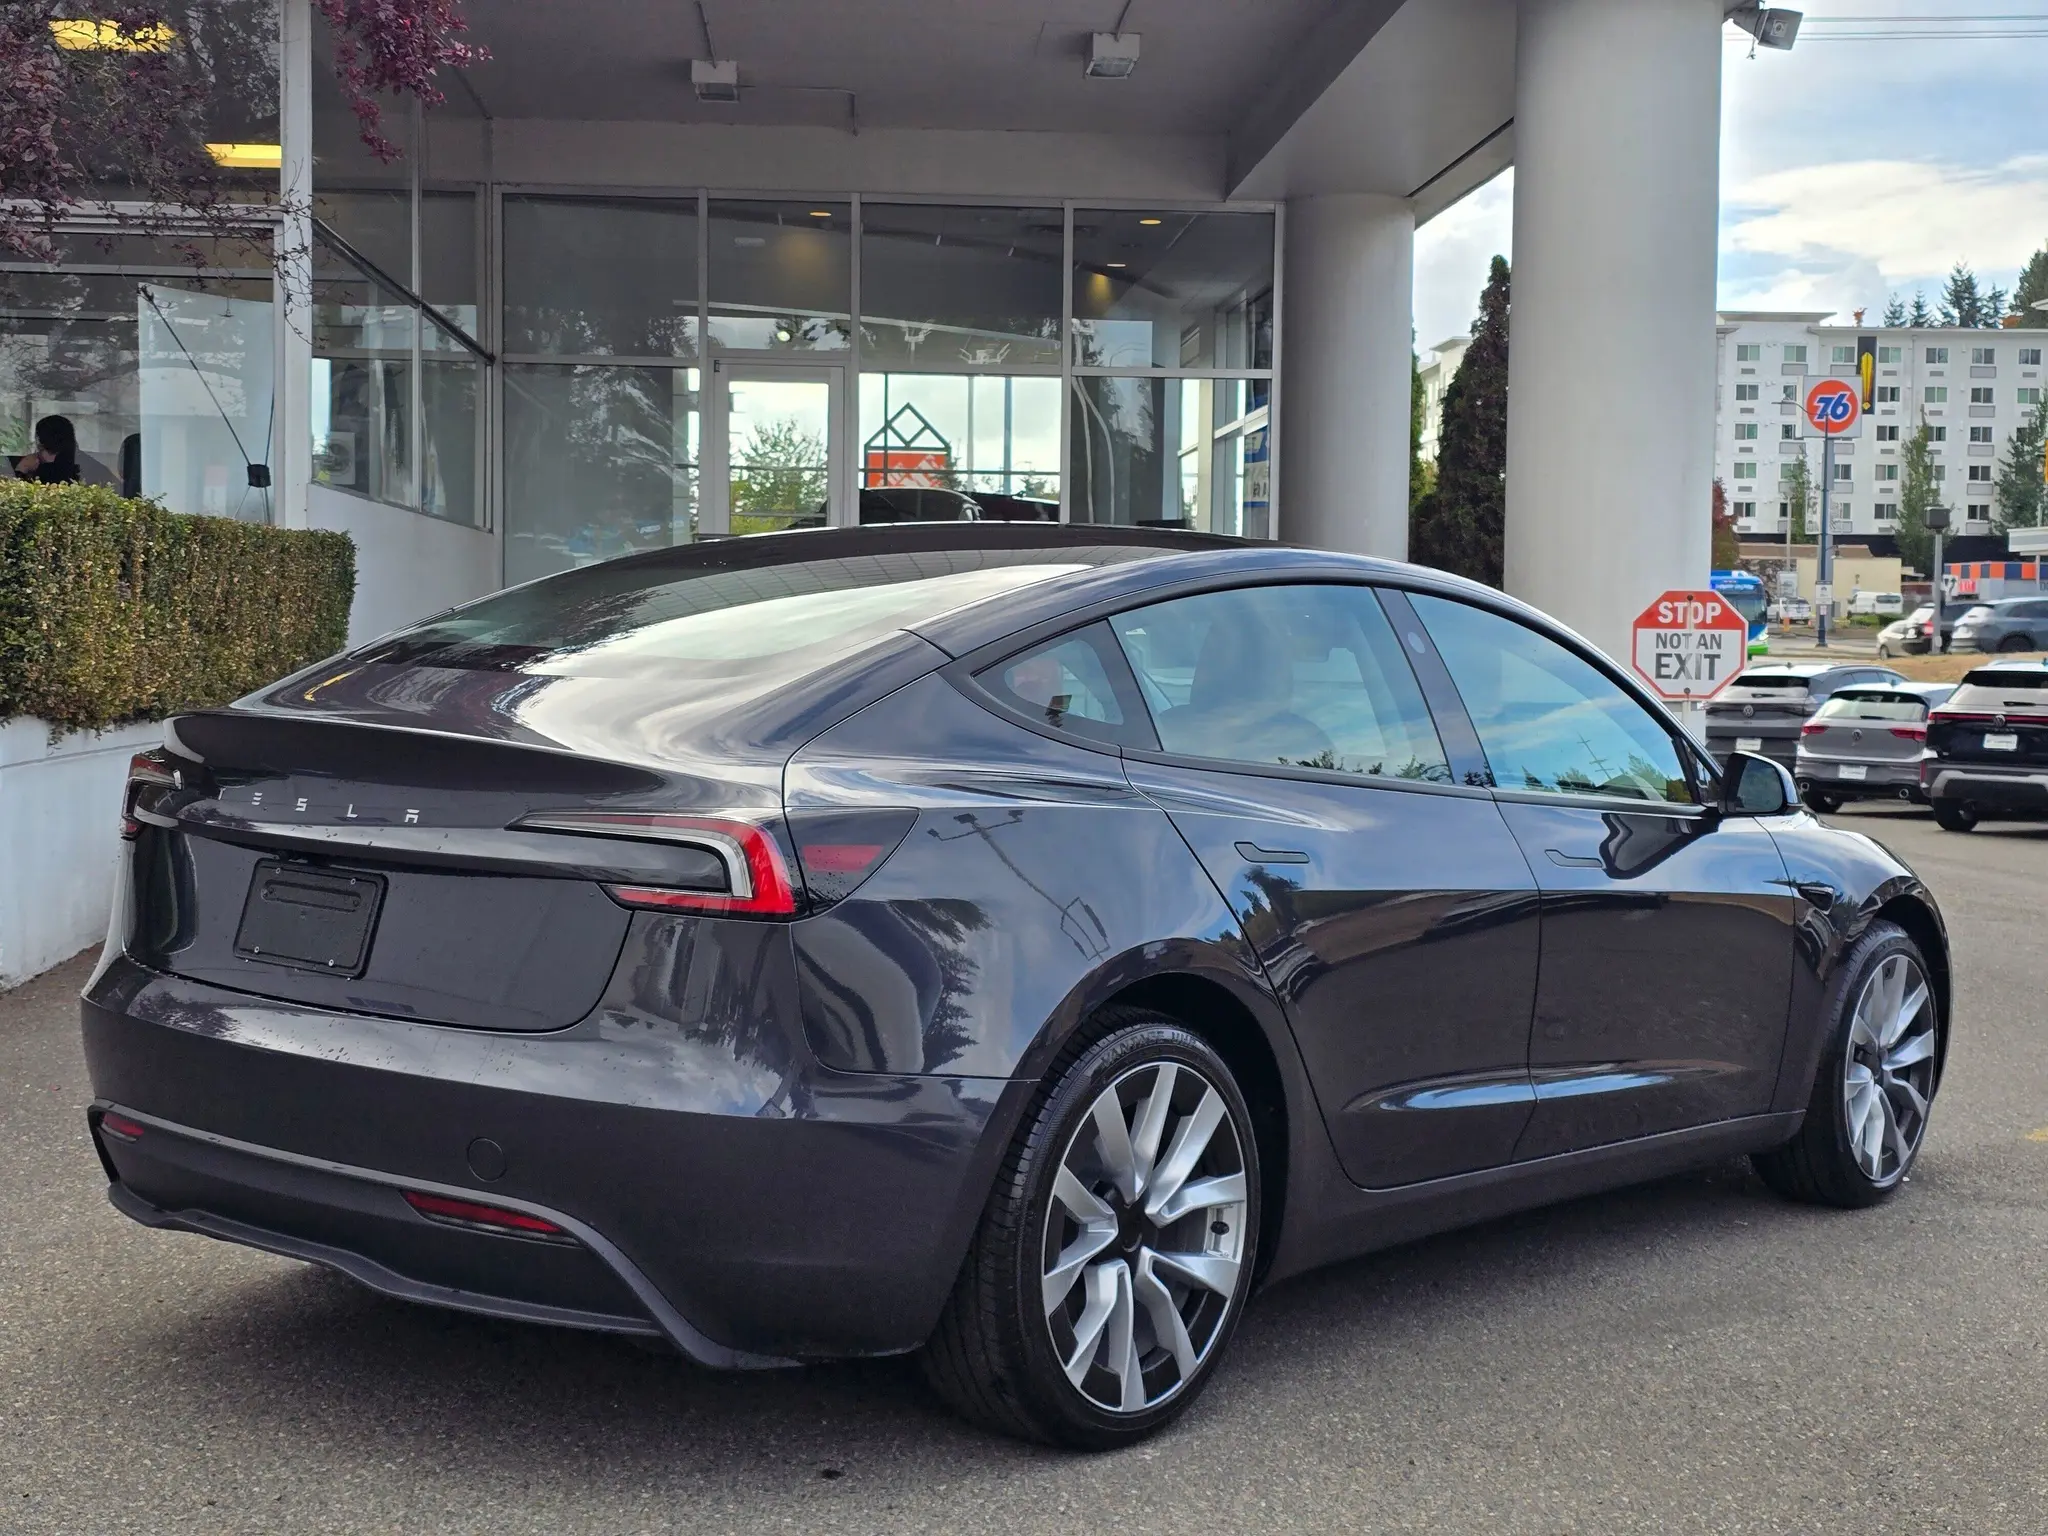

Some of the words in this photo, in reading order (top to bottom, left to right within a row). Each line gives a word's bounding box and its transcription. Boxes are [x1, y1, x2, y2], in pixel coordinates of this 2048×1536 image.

[1813, 391, 1852, 422] 76
[1657, 601, 1722, 624] STOP
[1655, 632, 1692, 649] NOT
[1696, 633, 1722, 650] AN
[1654, 652, 1721, 680] EXIT
[217, 786, 420, 824] TESLA
